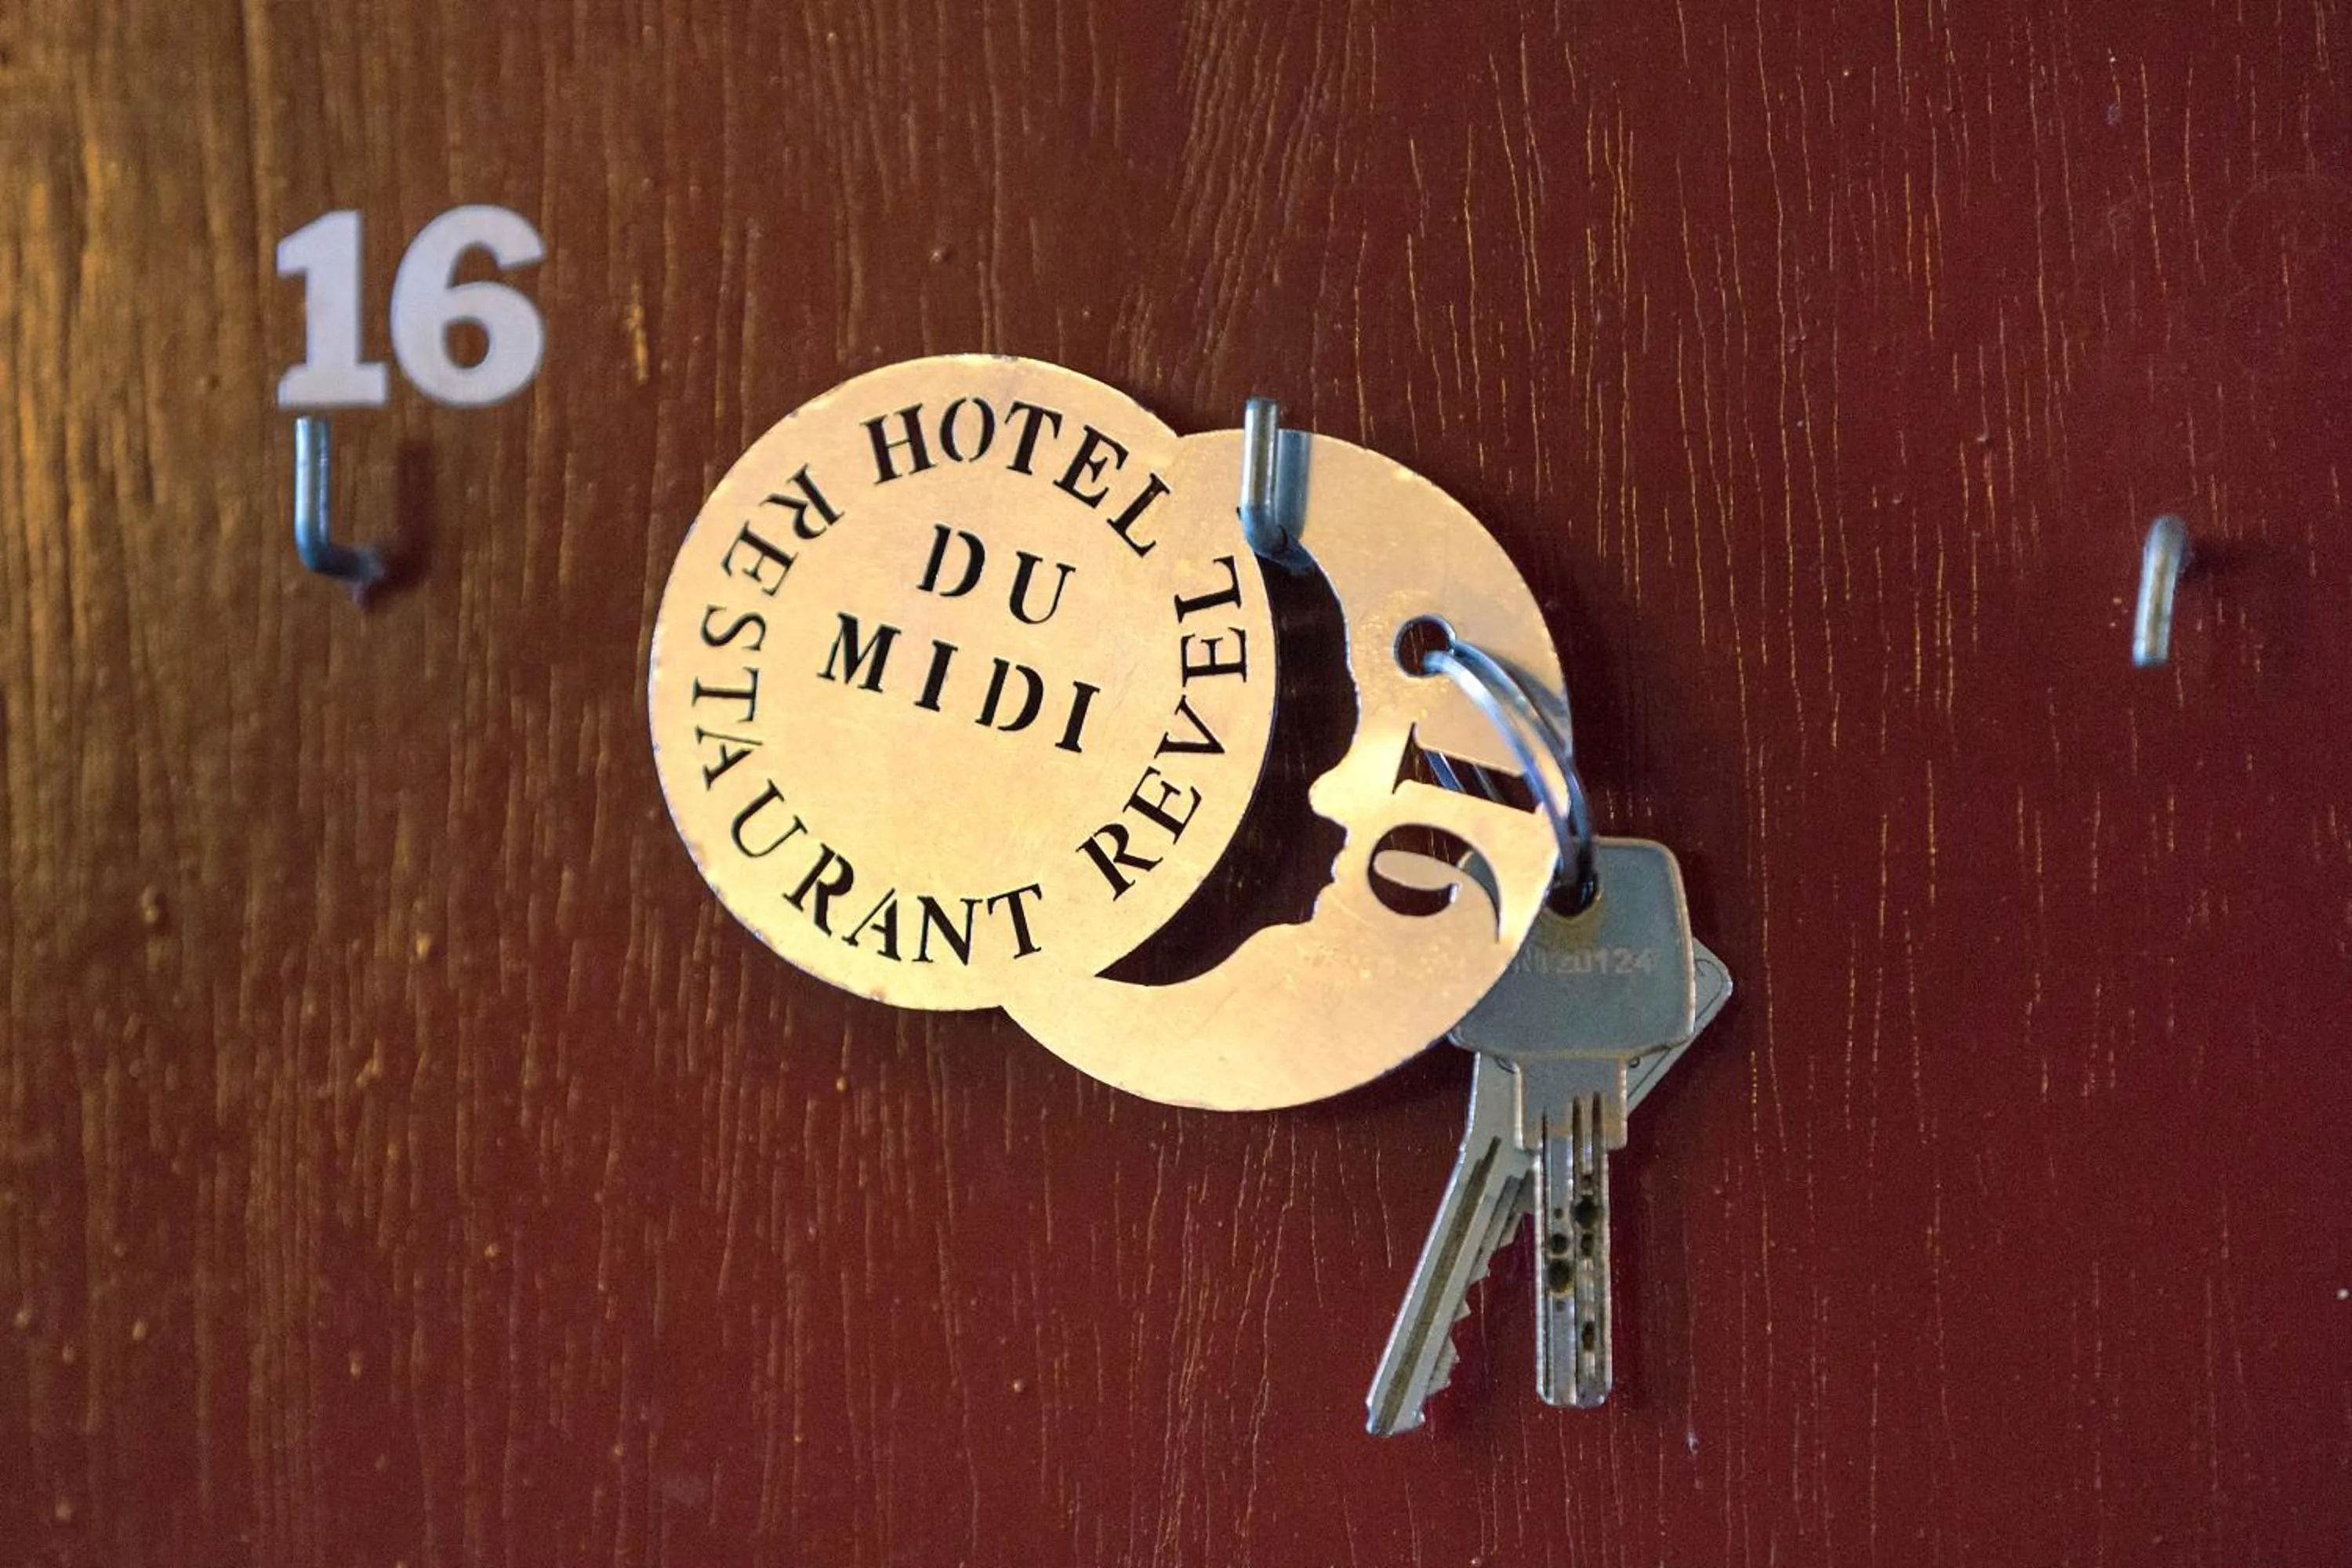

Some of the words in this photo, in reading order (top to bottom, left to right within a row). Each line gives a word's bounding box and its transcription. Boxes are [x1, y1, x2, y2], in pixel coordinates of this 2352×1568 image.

[277, 203, 546, 409] 16
[862, 396, 1171, 558] HOTEL
[917, 524, 1076, 626] DU
[691, 463, 1043, 966] RESTAURANT
[1075, 554, 1248, 902] REVEL
[818, 612, 1102, 753] MIDI
